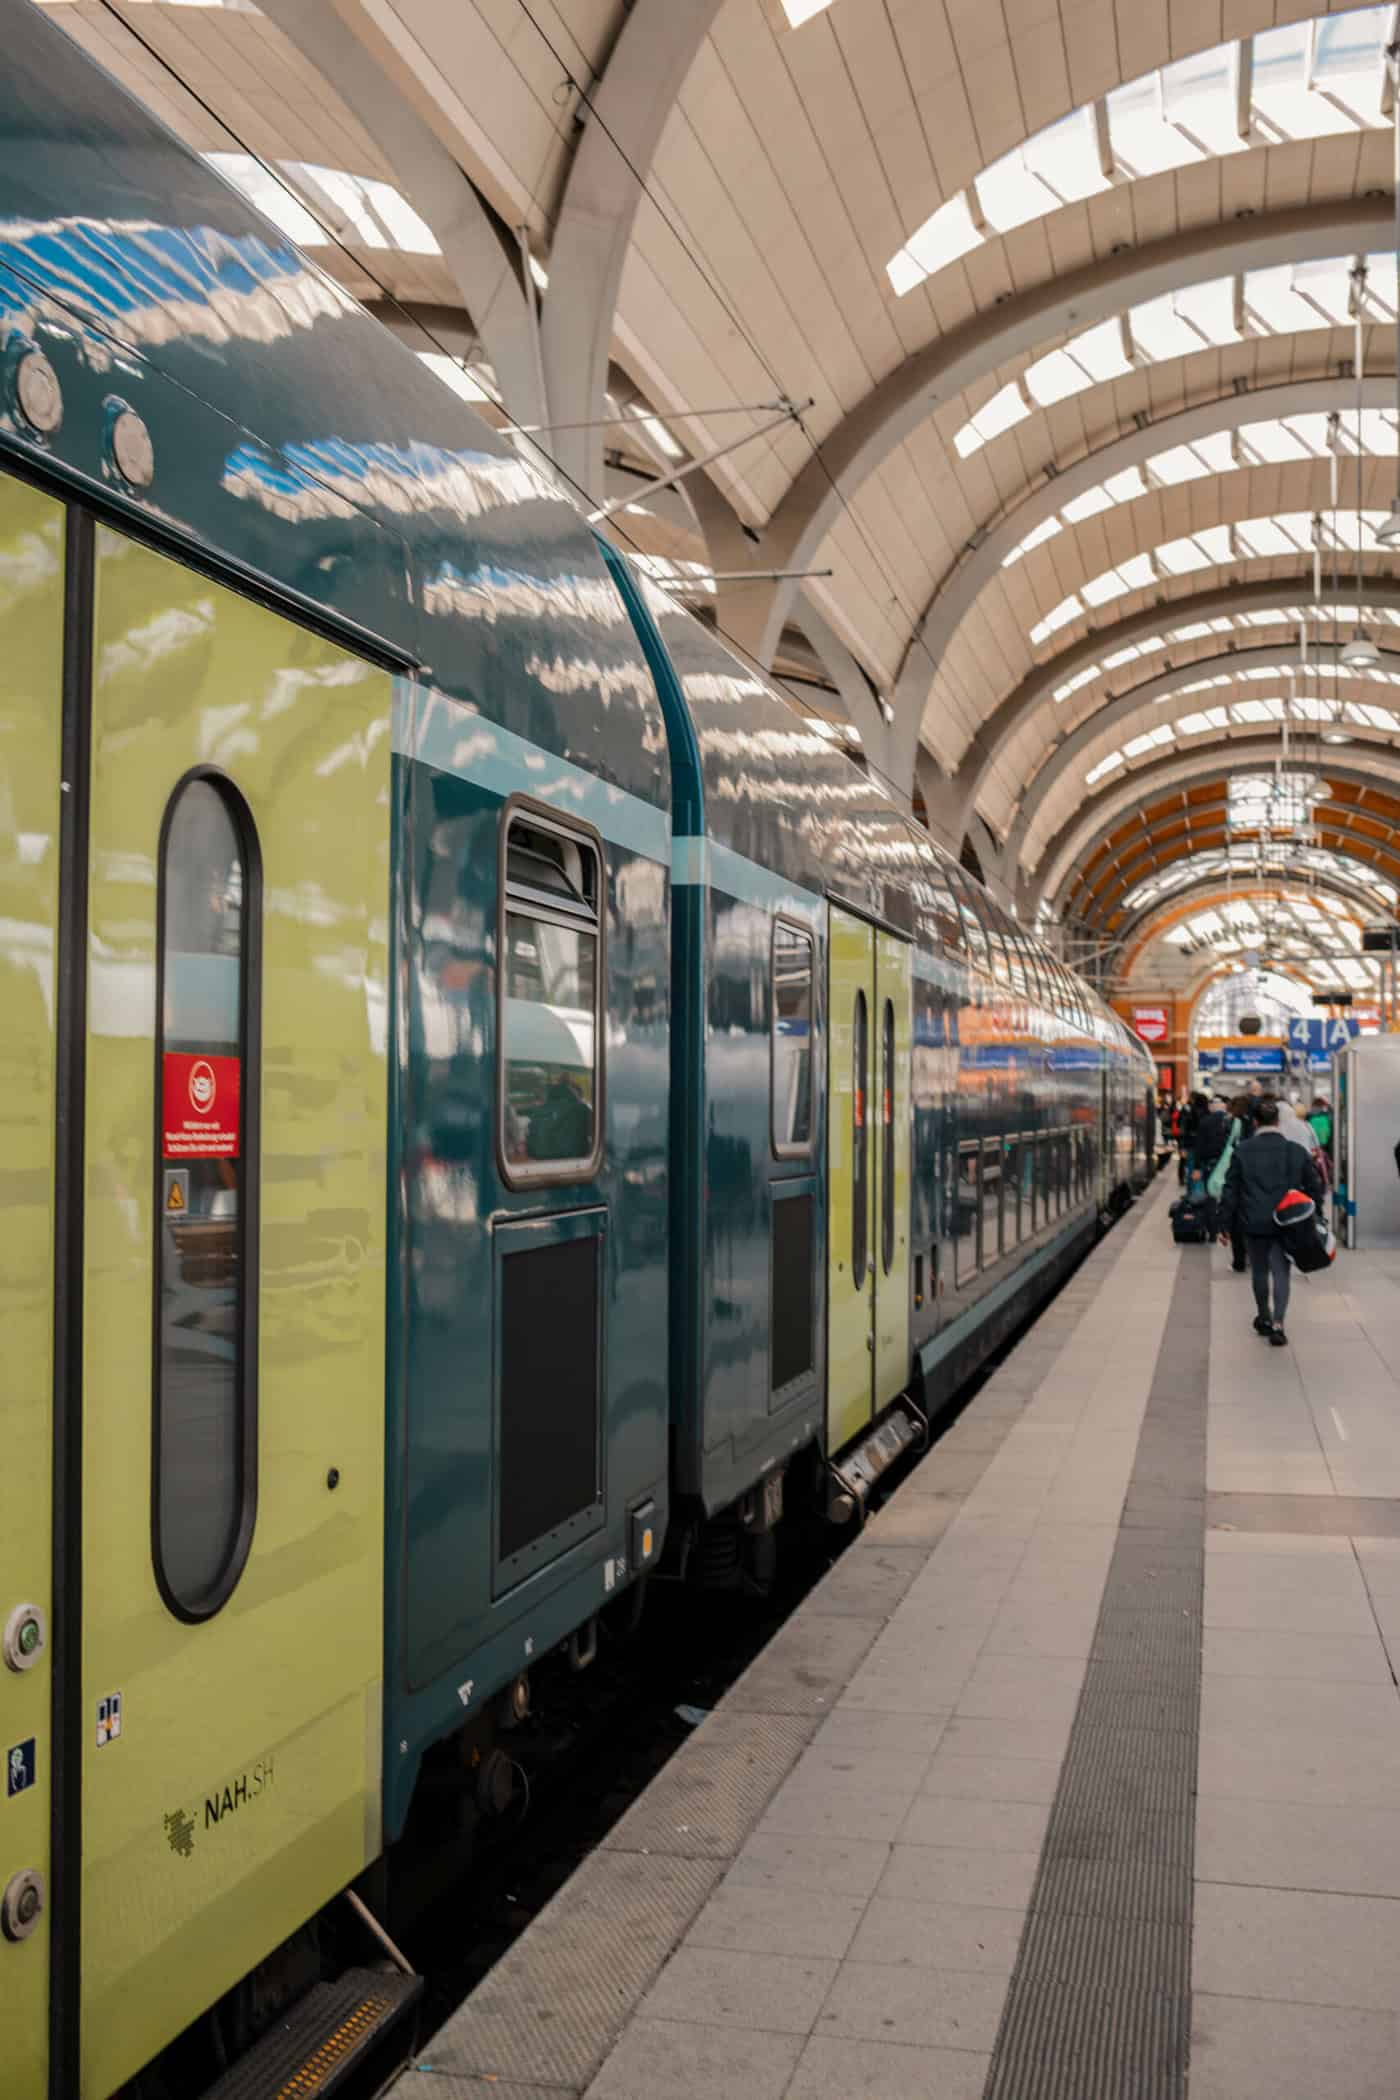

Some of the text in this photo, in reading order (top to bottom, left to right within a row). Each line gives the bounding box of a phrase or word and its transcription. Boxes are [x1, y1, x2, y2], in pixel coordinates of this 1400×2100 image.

[1292, 1020, 1352, 1046] 4 A
[205, 1756, 274, 1830] NAH.SH
